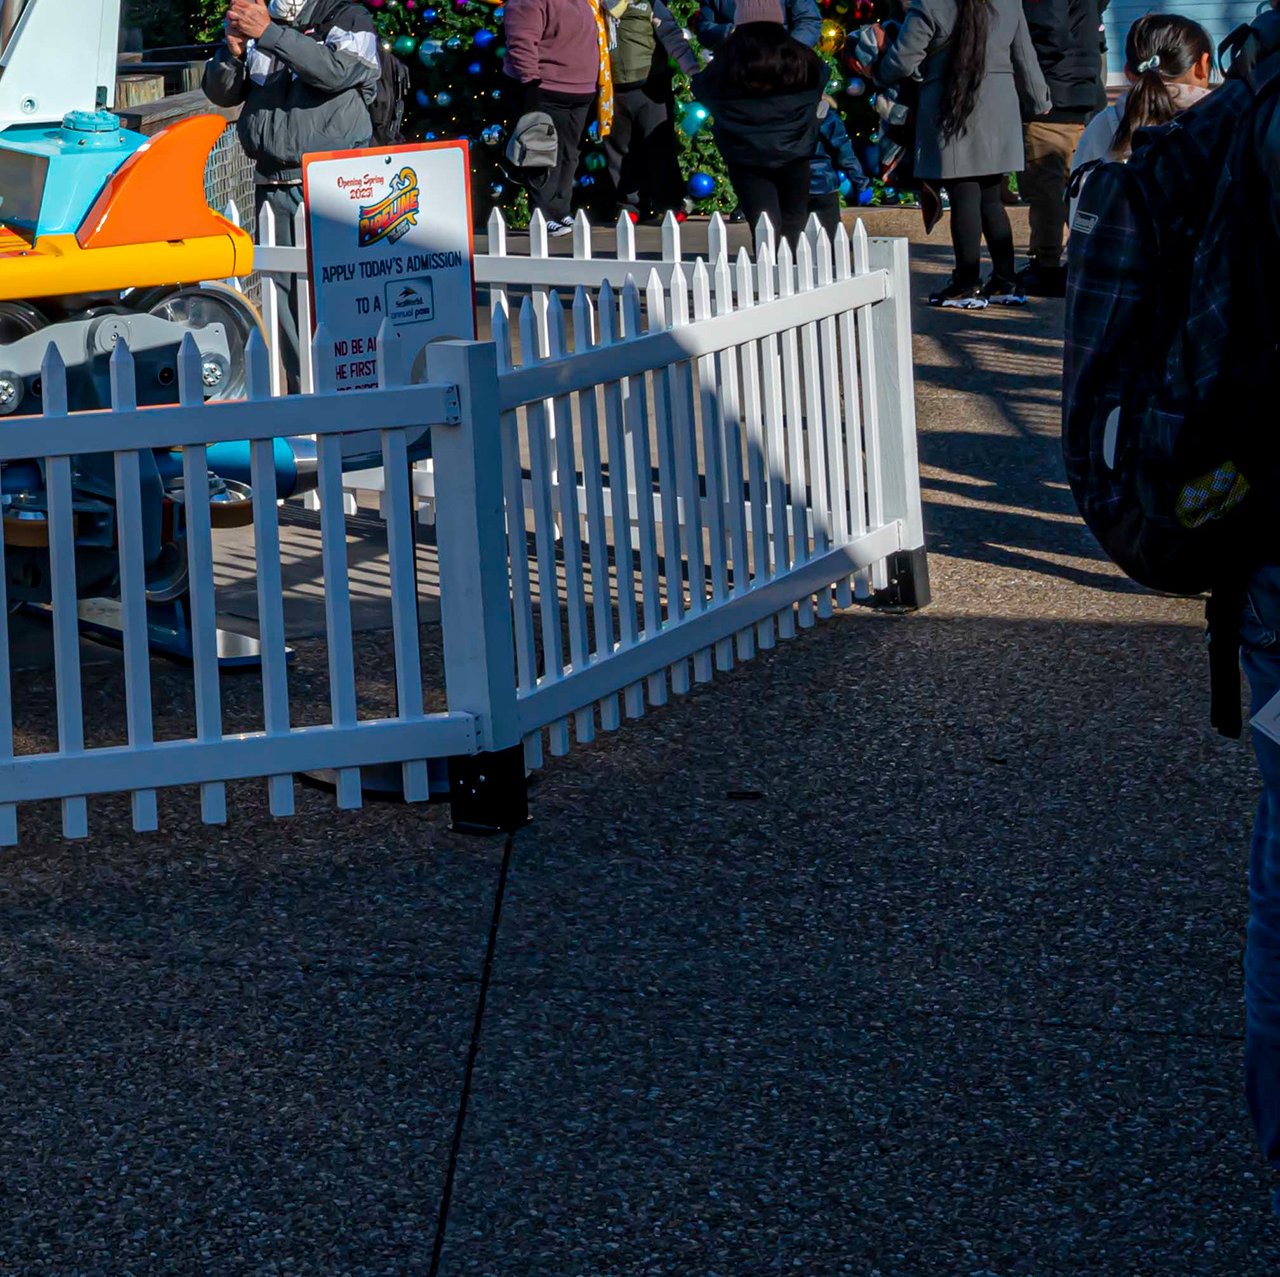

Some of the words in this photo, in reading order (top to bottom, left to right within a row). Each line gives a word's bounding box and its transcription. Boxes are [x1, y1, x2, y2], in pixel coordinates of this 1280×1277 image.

[337, 176, 362, 189] Opening
[363, 173, 385, 186] Spring
[359, 188, 419, 242] PIPELINE
[322, 263, 355, 284] APPLY
[358, 257, 403, 279] TODAY'S
[355, 297, 370, 315] TO
[373, 295, 382, 313] A
[391, 308, 414, 320] annual
[334, 341, 348, 358] ND
[351, 338, 364, 355] BE
[335, 363, 348, 381] HE
[350, 359, 377, 379] FIRST
